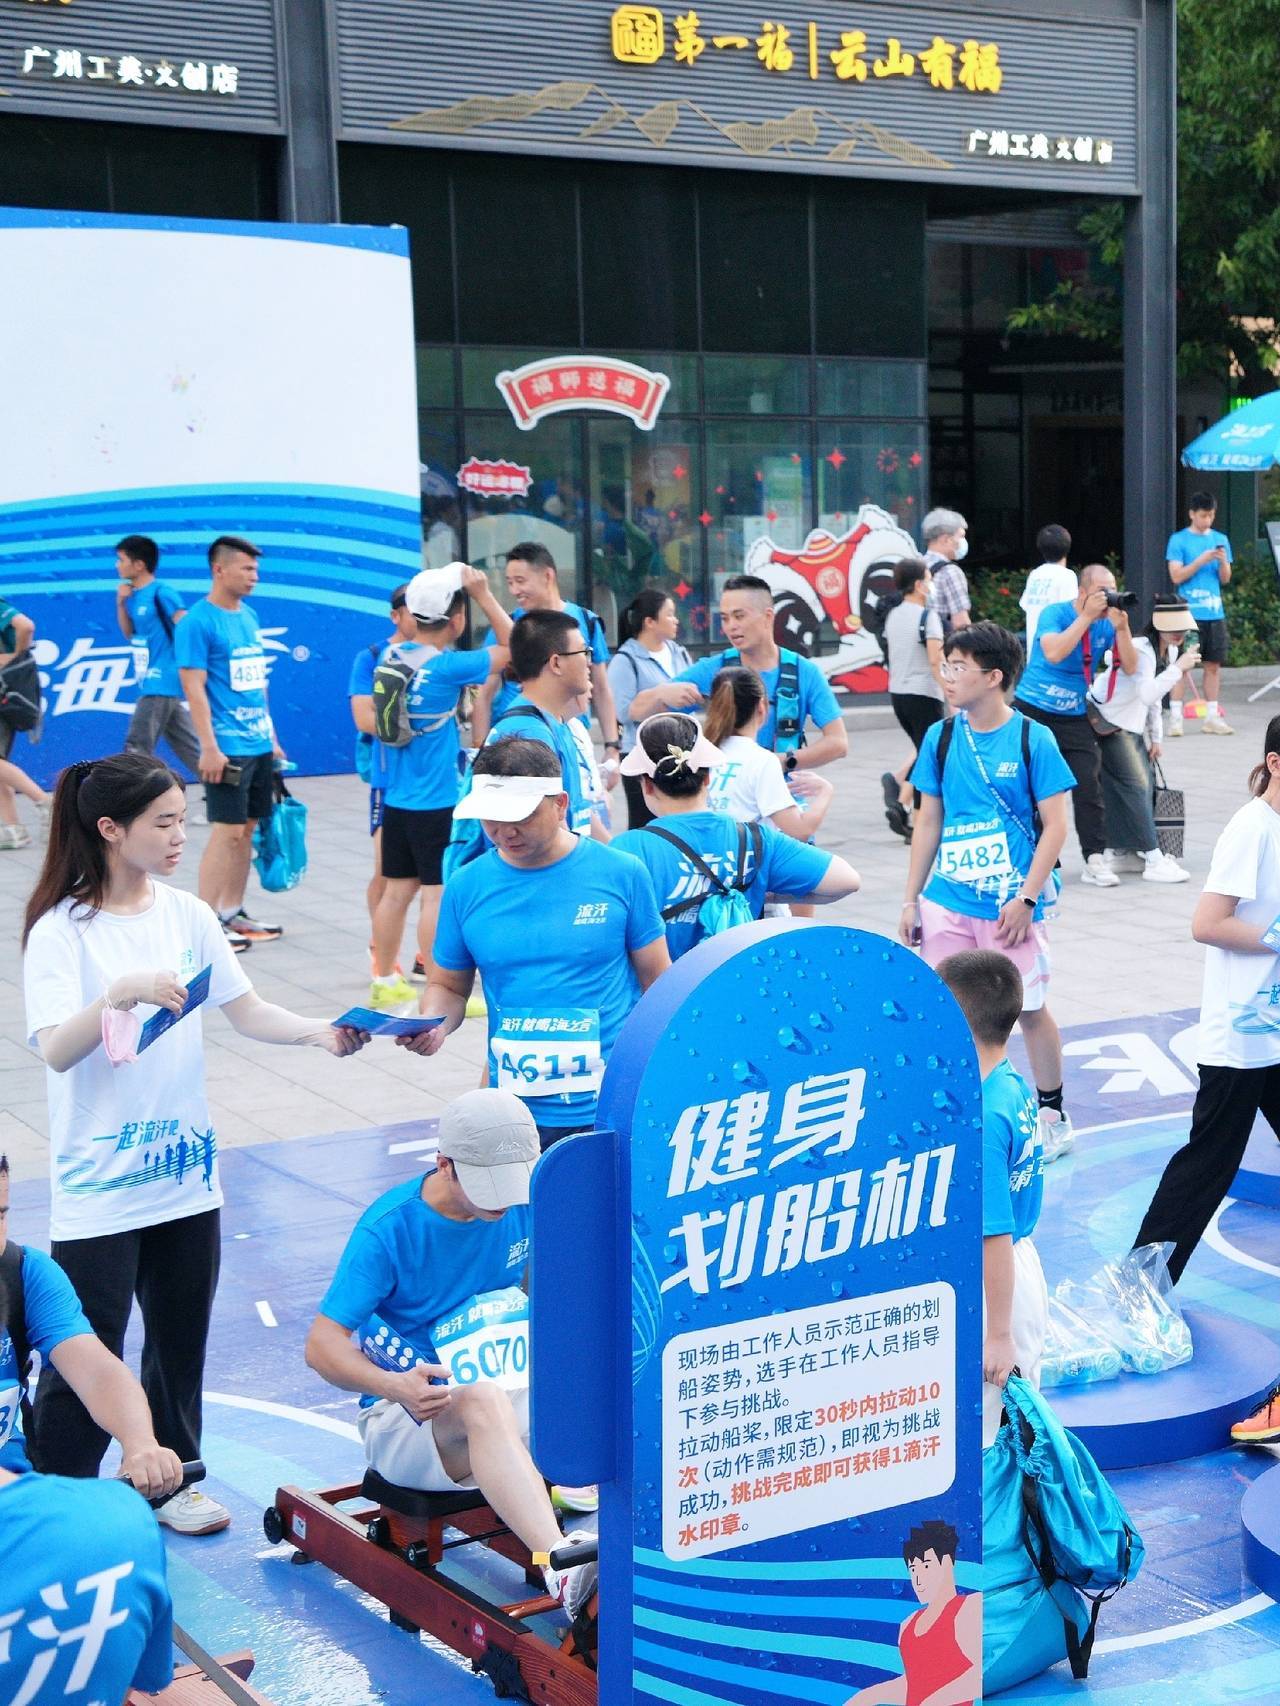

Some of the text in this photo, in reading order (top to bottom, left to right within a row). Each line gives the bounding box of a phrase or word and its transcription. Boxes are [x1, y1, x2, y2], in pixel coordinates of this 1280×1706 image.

[830, 30, 1003, 94] 云山有福
[945, 842, 1007, 875] 5482
[502, 1052, 593, 1083] 4611
[92, 1119, 180, 1153] 一起流汗吧
[666, 1066, 868, 1199] 健身
[660, 1144, 958, 1296] 划船机
[450, 1335, 528, 1385] 6070
[678, 1297, 940, 1372] 现场由工作人员示范正确的划
[678, 1326, 940, 1401] 船姿势，选手在工作人员指导
[678, 1387, 790, 1430] 下参与挑战。
[678, 1434, 941, 1518] 成功，挑战完成即可获得1滴汗
[678, 1512, 749, 1548] 水印章。
